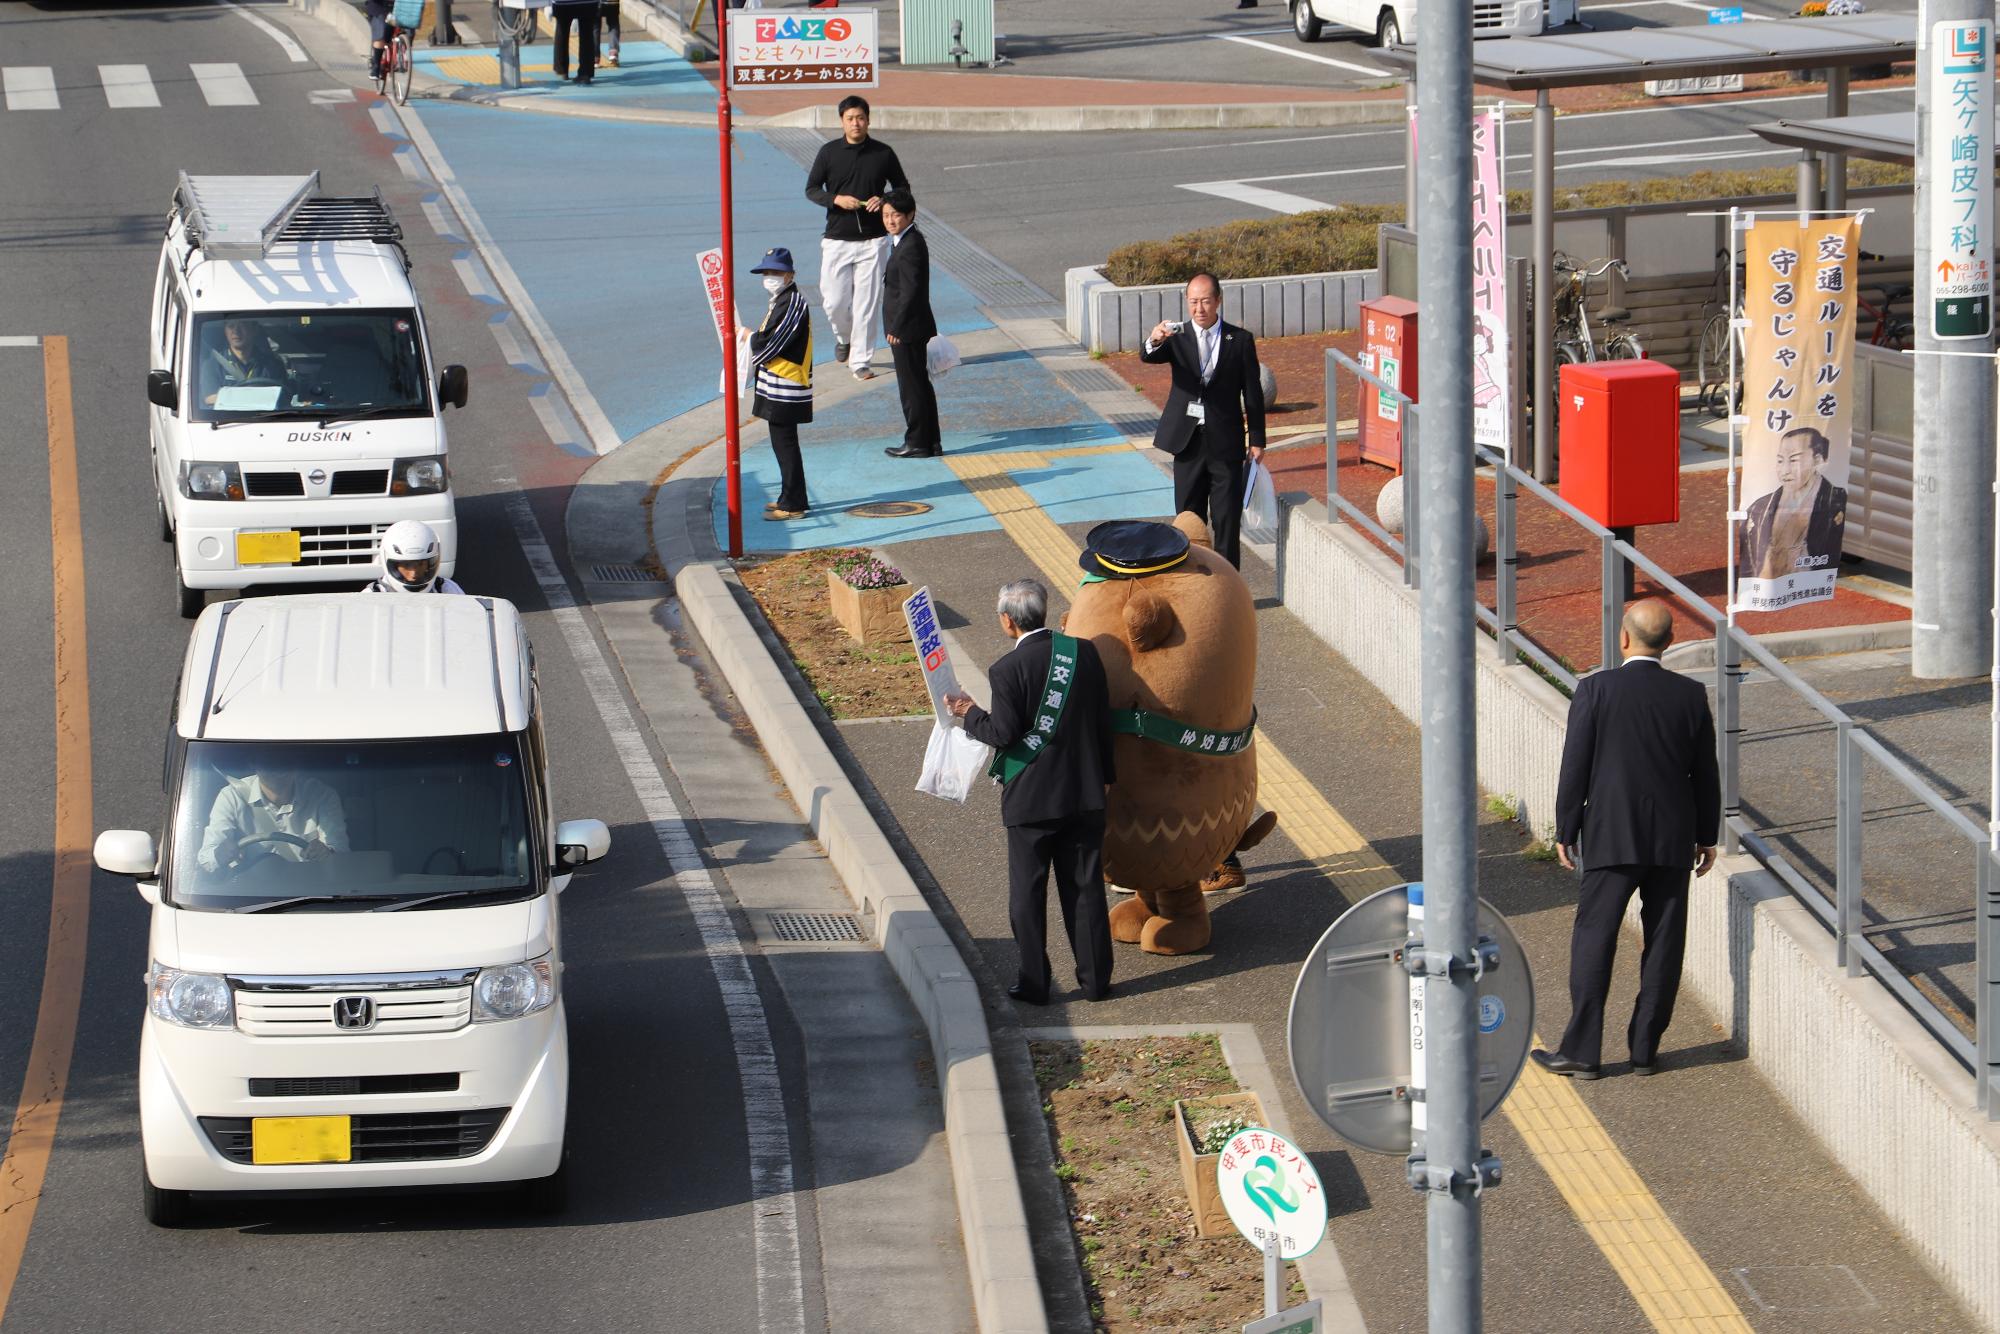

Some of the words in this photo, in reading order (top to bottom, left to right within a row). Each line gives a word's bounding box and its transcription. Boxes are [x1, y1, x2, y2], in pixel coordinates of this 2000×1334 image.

[757, 19, 848, 40] さいとう
[738, 43, 869, 62] こどもクリニック
[737, 66, 869, 82] 双葉インターから3分
[1385, 325, 1396, 342] 02
[1767, 249, 1798, 432] 守るじゃんけ
[1817, 235, 1846, 417] 交通ルールを
[1023, 665, 1070, 750] 交通安全
[1222, 1133, 1317, 1194] 甲斐市民バス
